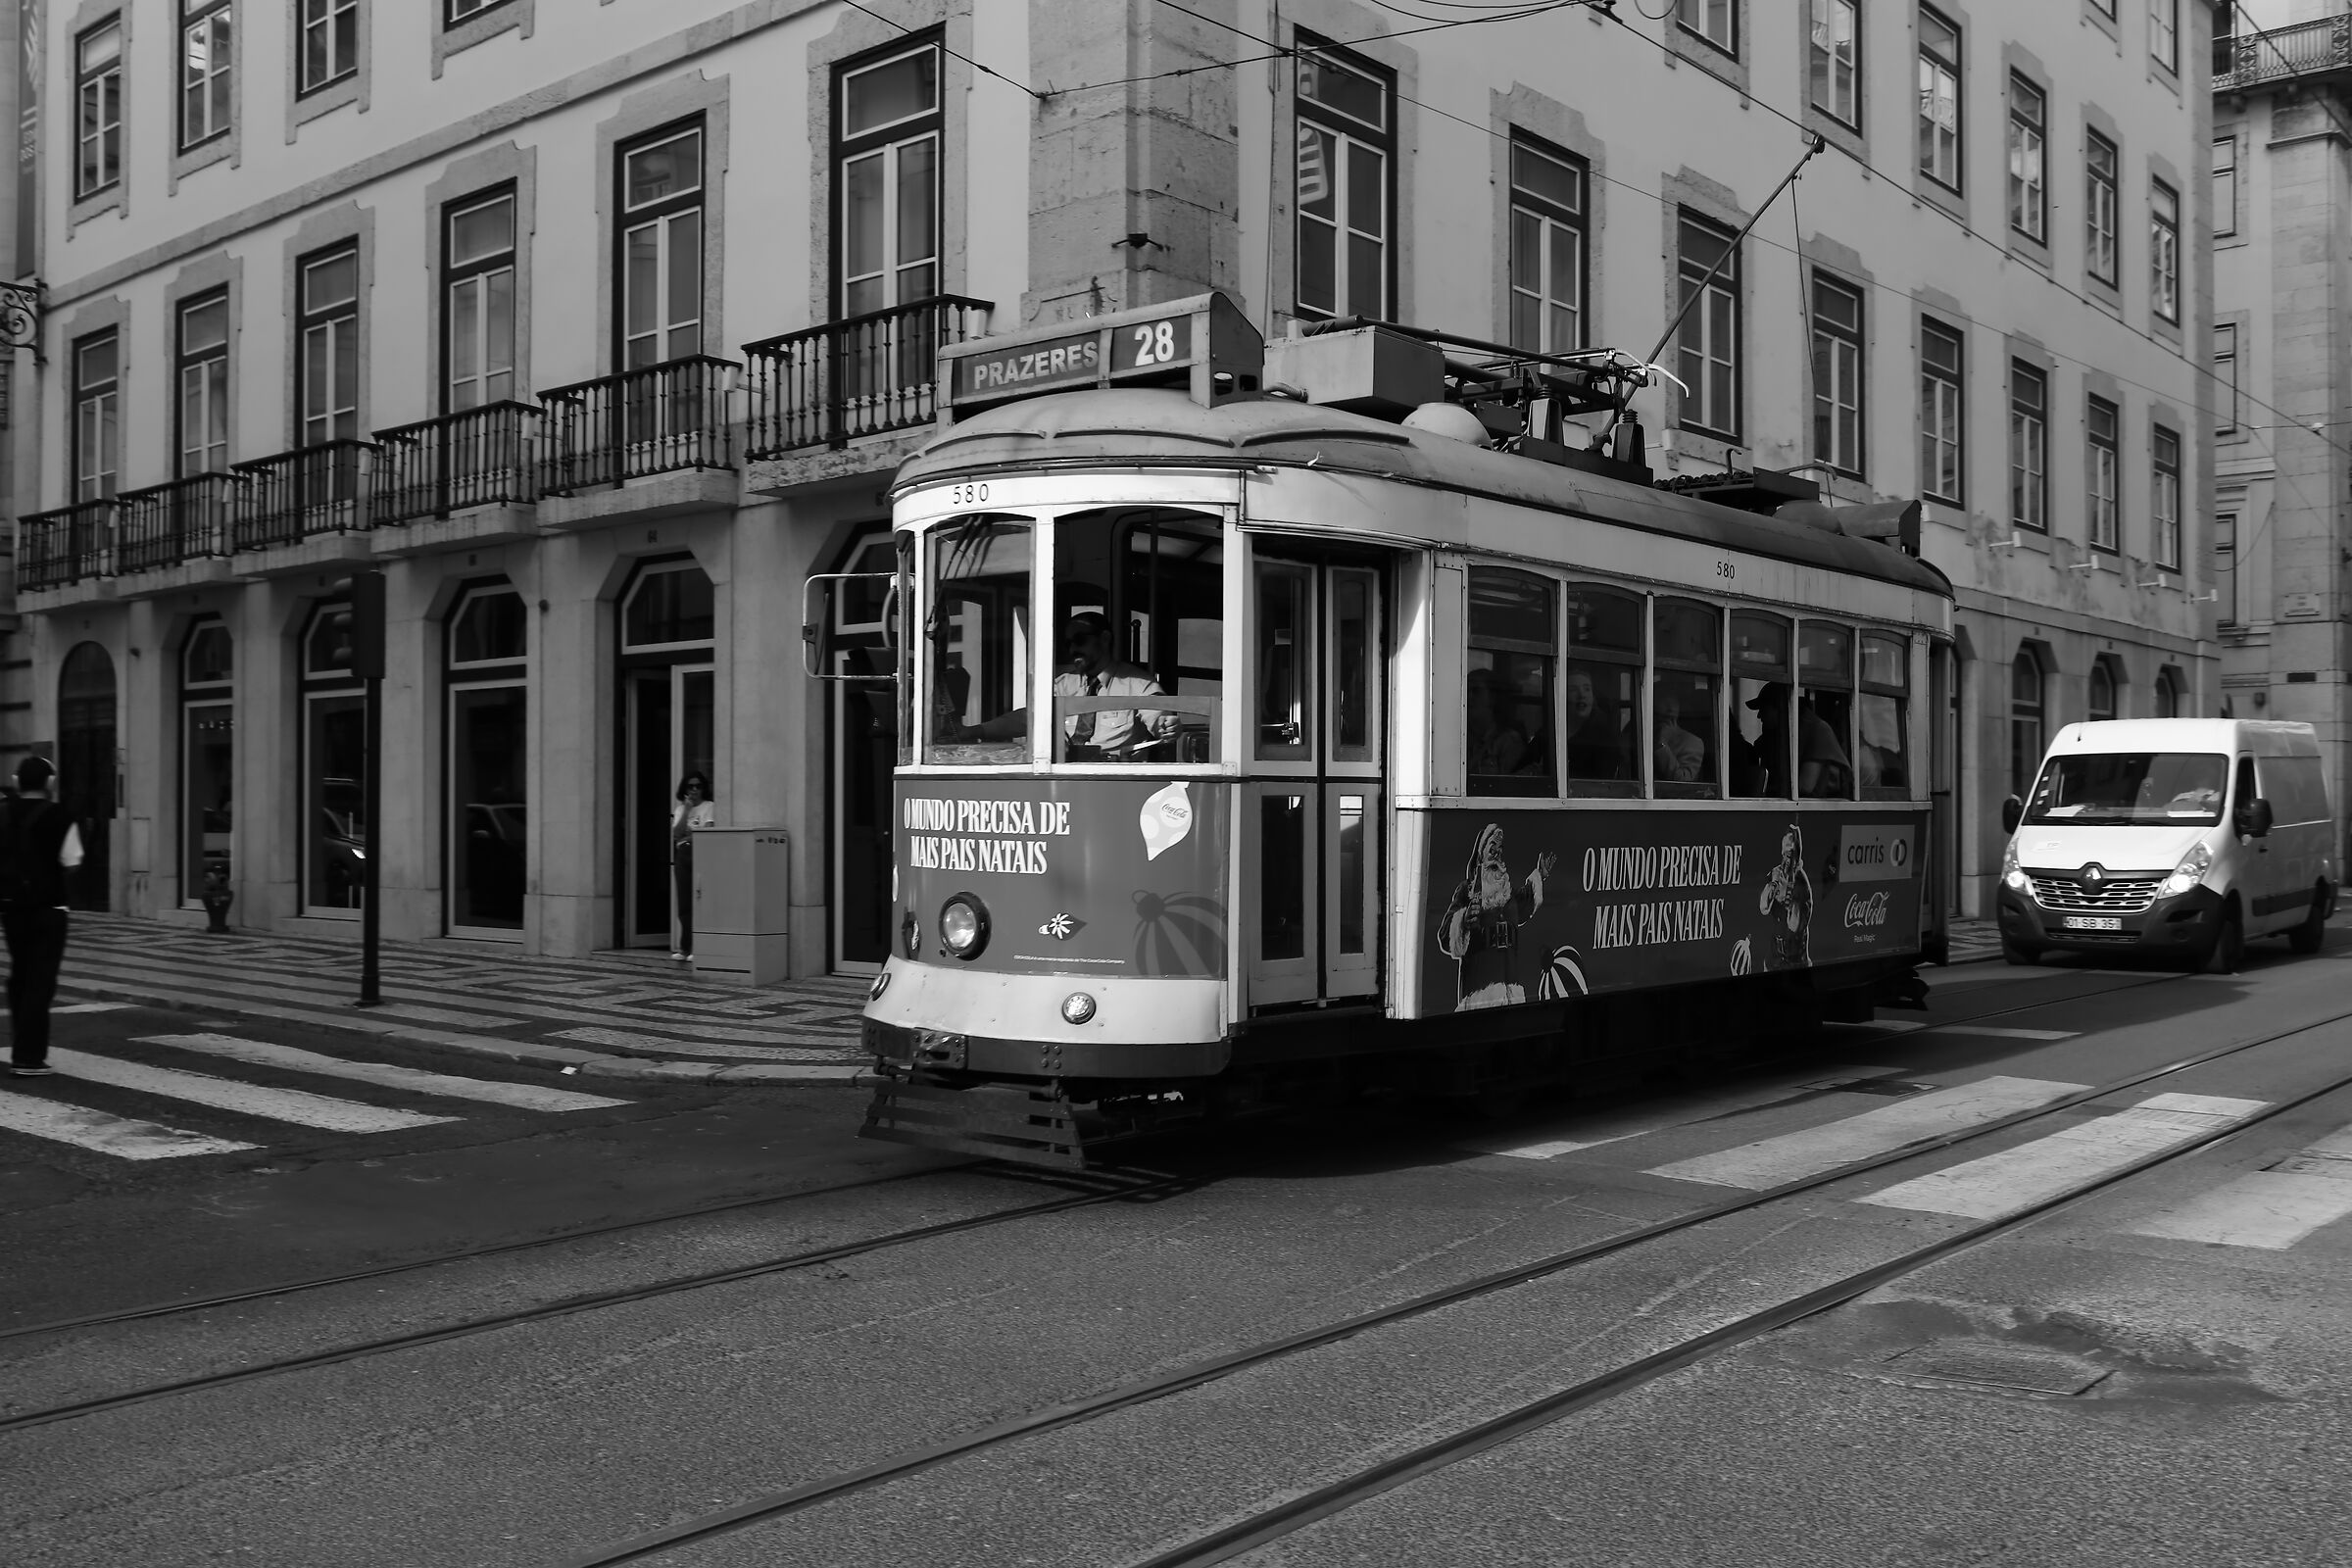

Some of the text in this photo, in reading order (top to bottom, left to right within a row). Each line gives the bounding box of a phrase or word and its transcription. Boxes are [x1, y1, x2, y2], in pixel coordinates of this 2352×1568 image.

[1134, 320, 1175, 368] 28
[974, 341, 1100, 390] PRAZERES
[953, 483, 990, 505] 580
[1716, 561, 1736, 580] 580
[904, 798, 1070, 836] O MUNDO PRECISA DE
[910, 835, 1048, 875] MAIS PAIS NATAIS
[1582, 844, 1743, 892] O MUNDO PRECISA DE
[1847, 836, 1885, 864] carris
[1592, 898, 1725, 950] MAIS PAIS NATAIS
